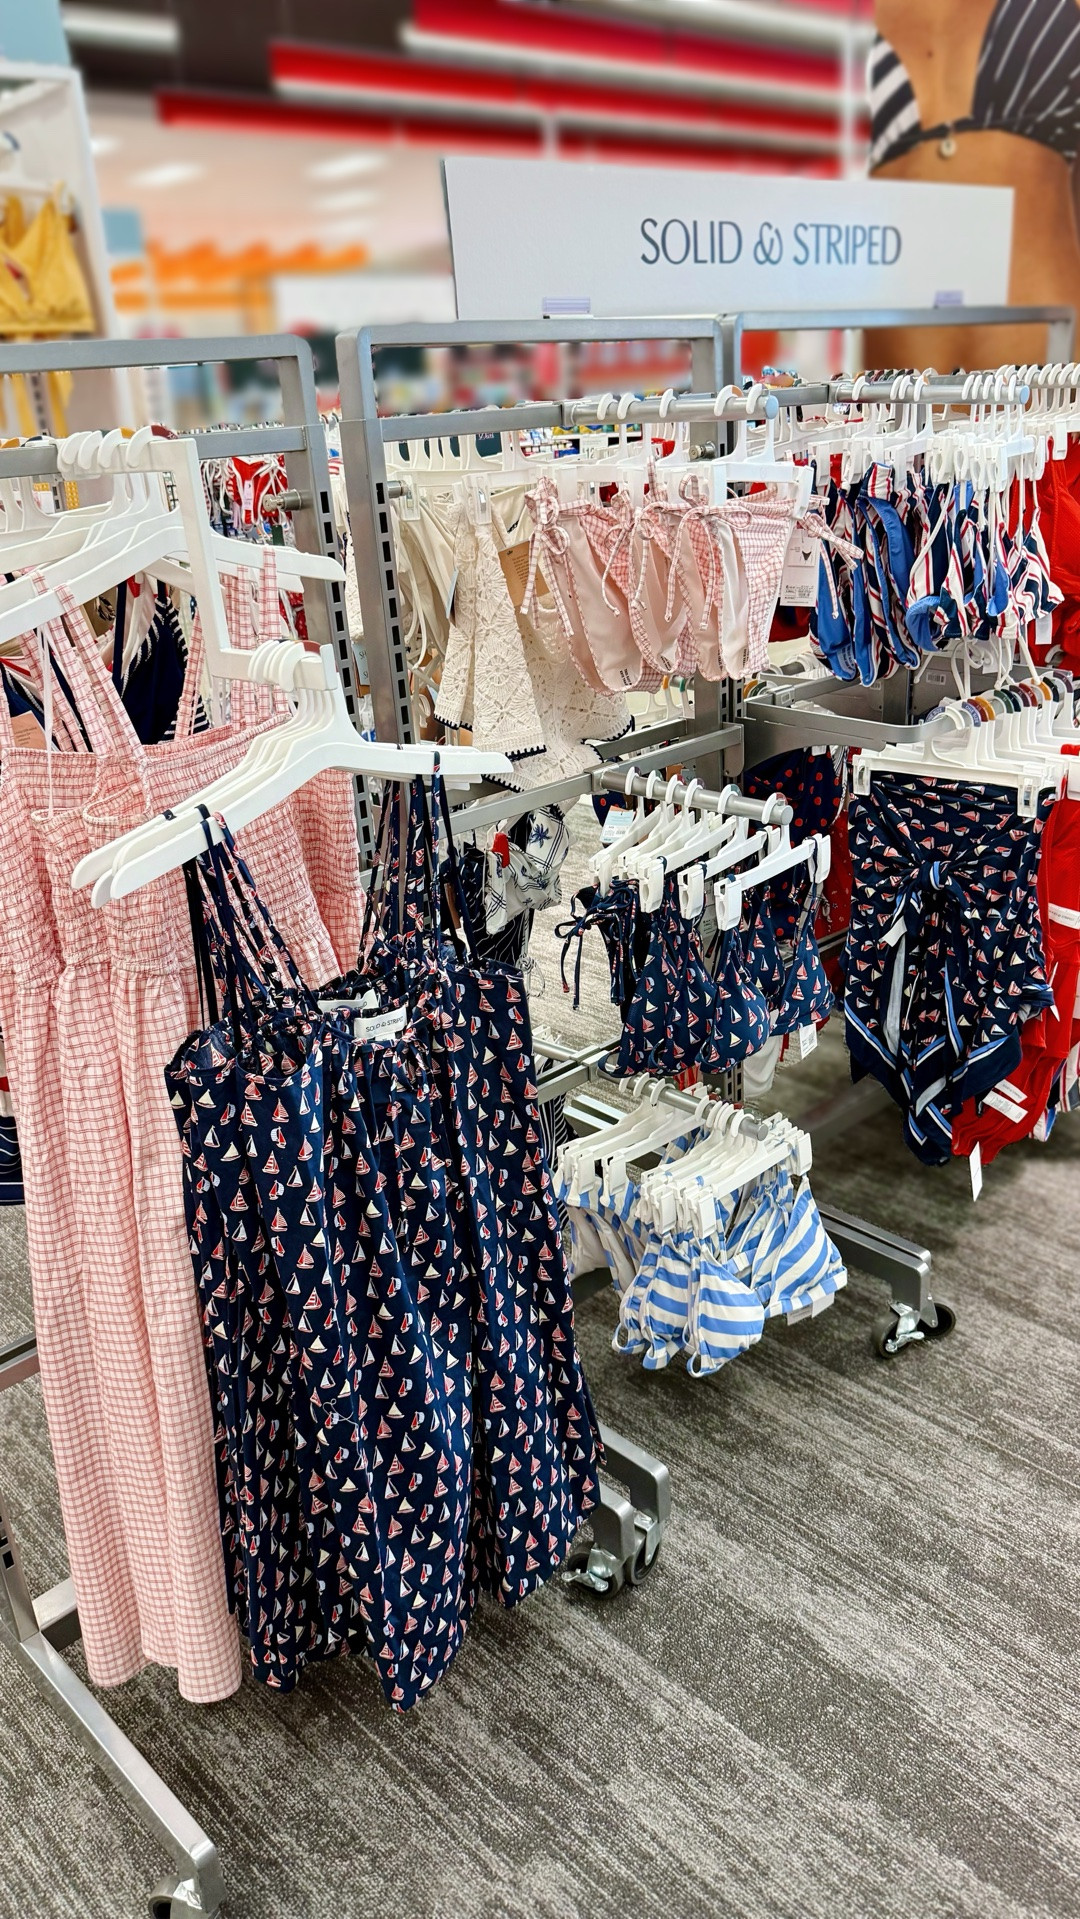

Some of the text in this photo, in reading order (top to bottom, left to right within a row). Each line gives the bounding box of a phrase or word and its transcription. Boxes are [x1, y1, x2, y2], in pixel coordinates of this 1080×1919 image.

[640, 217, 902, 266] SOLID & STRIPED
